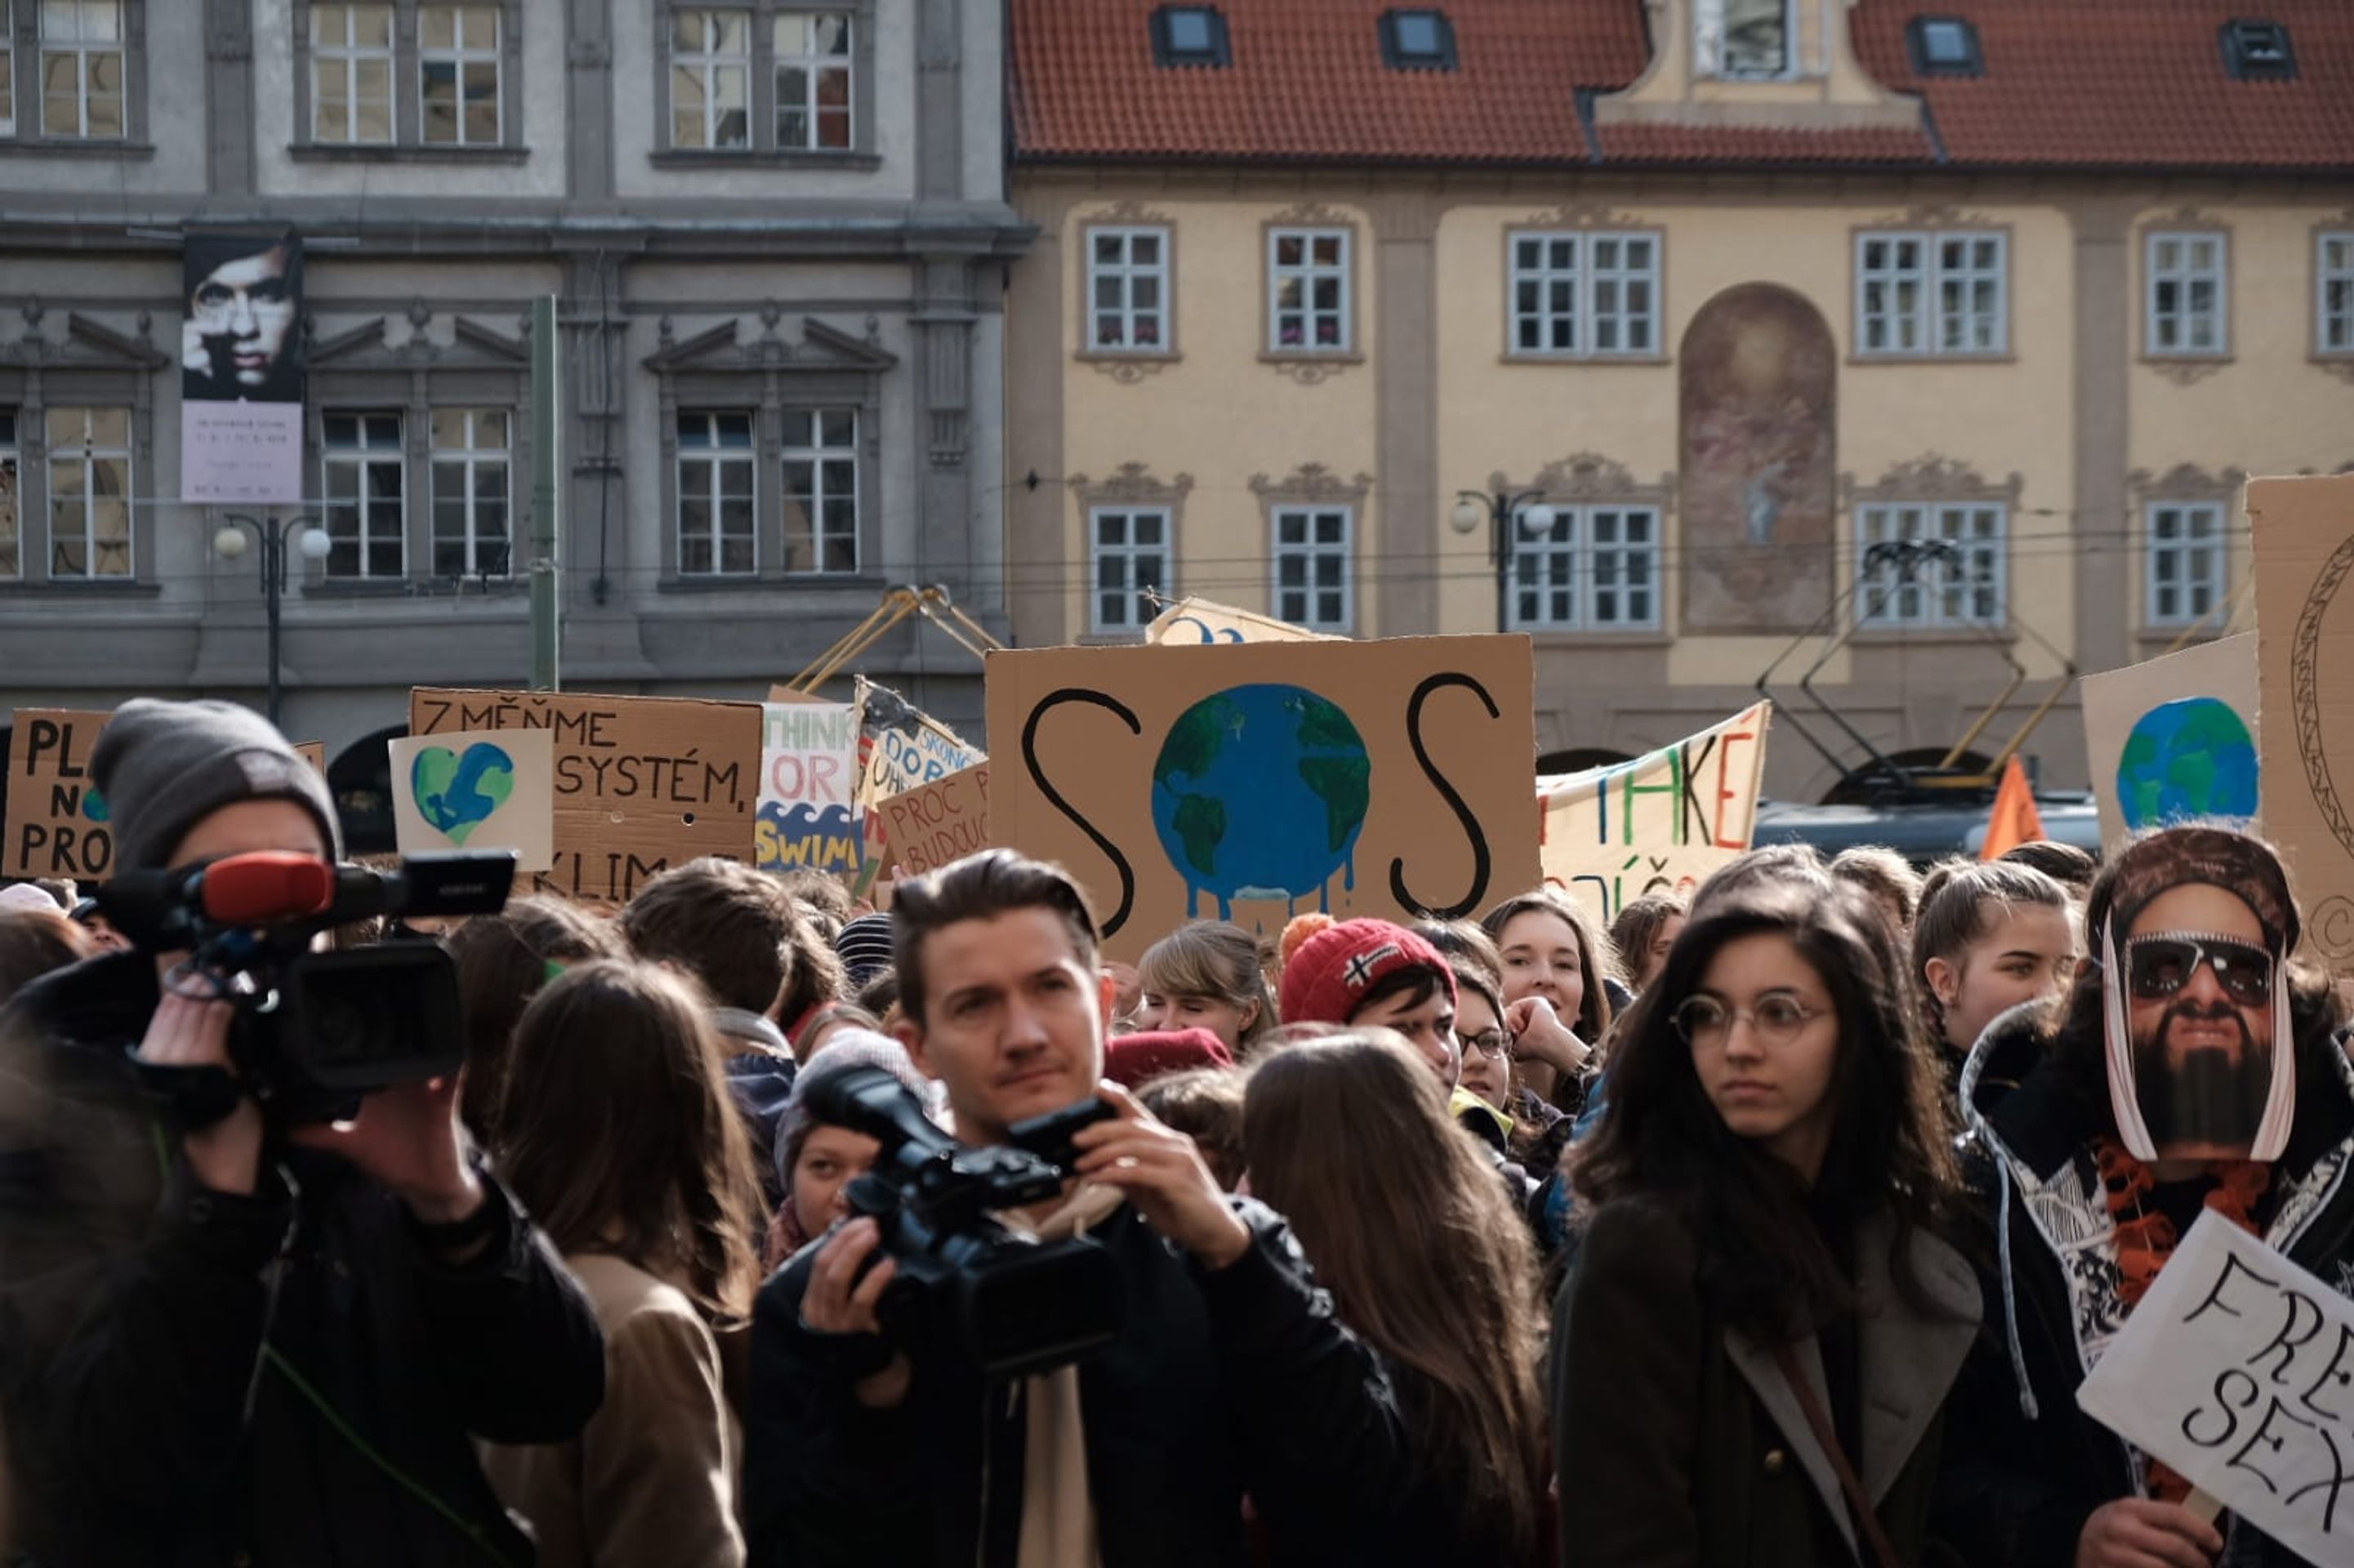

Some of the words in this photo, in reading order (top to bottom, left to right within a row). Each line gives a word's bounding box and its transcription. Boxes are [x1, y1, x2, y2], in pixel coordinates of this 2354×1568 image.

[765, 710, 854, 750] THINK
[554, 748, 746, 813] SYSTÉM,
[771, 755, 838, 801] OR
[756, 819, 857, 866] SWIM
